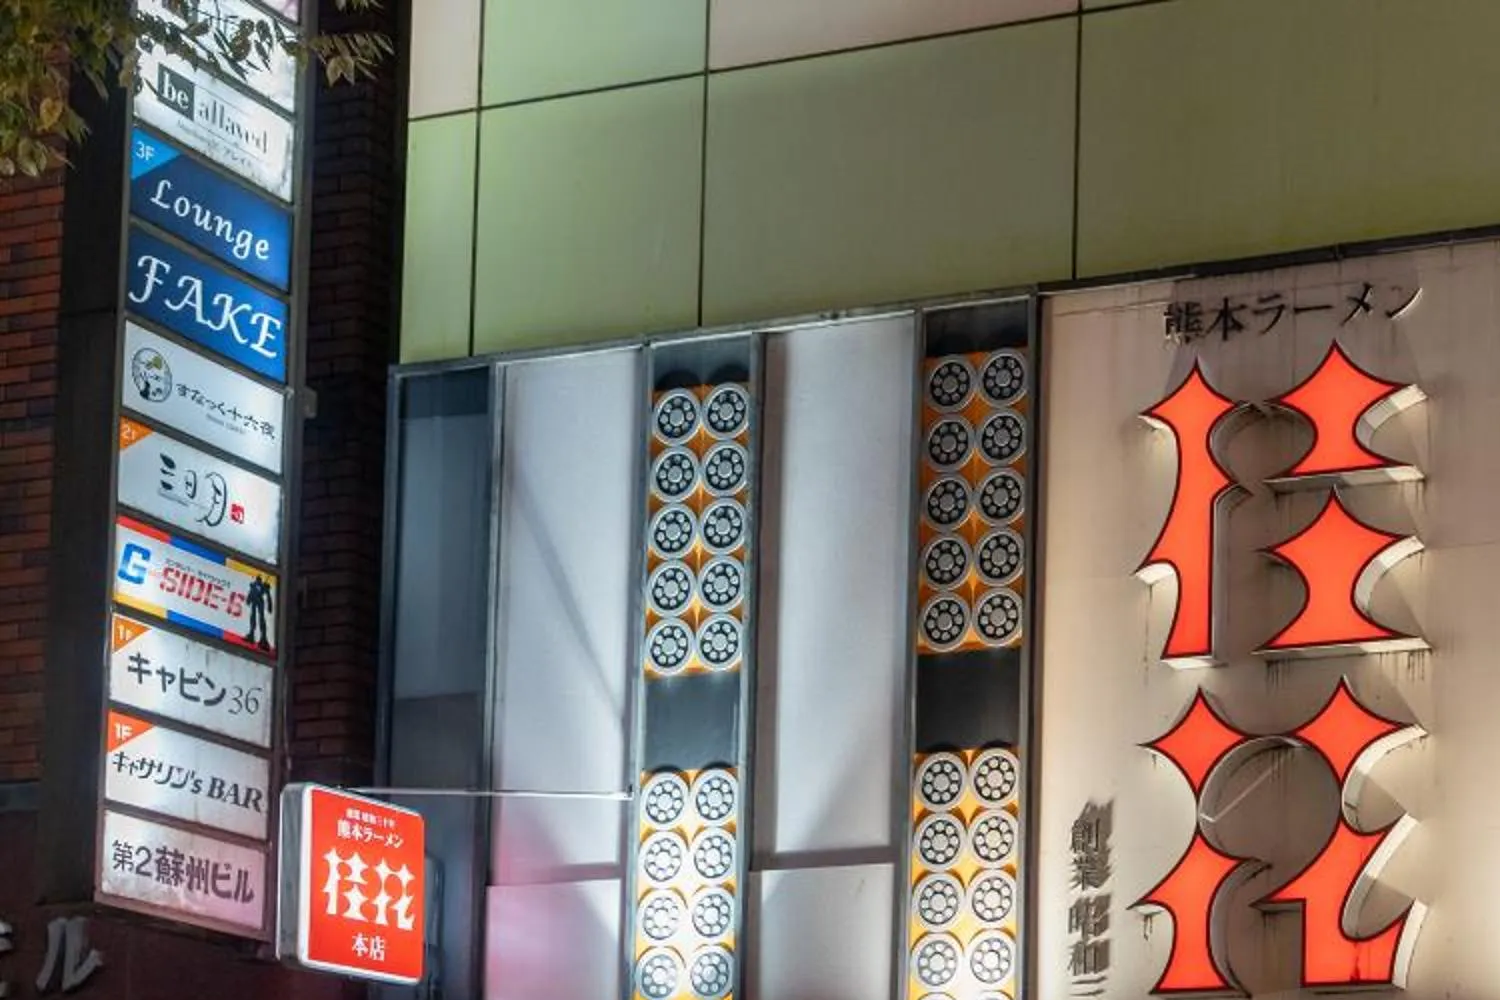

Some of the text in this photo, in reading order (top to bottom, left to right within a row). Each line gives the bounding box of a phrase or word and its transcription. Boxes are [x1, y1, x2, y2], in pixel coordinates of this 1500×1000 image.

[162, 73, 189, 109] be
[135, 141, 155, 161] 3F
[150, 179, 270, 260] Lounge
[128, 255, 281, 359] FAKE
[1163, 283, 1423, 344] 熊本ラーメン
[116, 541, 152, 586] G
[1130, 338, 1430, 1000] 桂花
[114, 722, 133, 740] 1F
[112, 751, 264, 813] キャサリン's BAR
[111, 839, 255, 904] 第2蘇州ビル
[322, 847, 415, 932] 桂花
[352, 932, 386, 962] 本店
